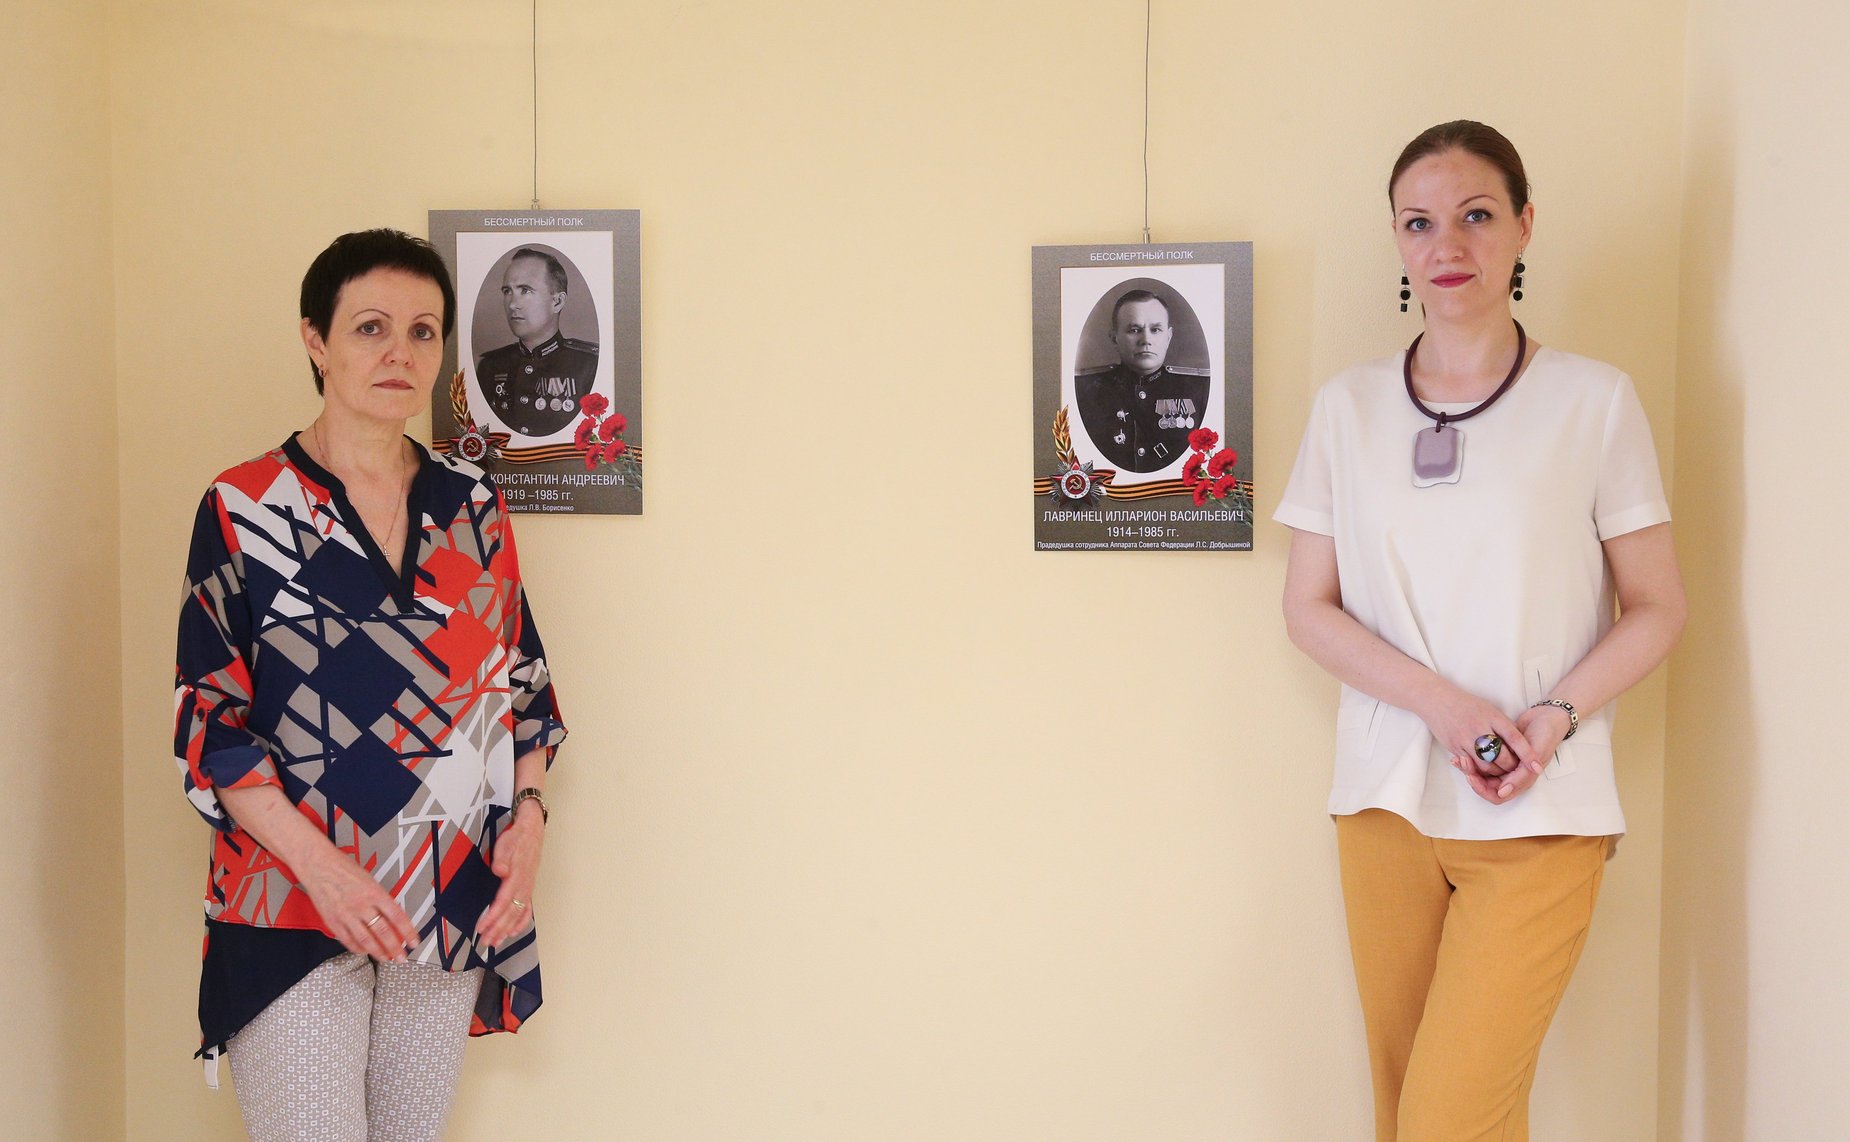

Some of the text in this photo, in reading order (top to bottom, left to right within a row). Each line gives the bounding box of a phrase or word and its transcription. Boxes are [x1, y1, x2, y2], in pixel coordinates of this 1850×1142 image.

[484, 216, 584, 226] БЕССМЕРТНЫЙ ПОЛК
[1090, 250, 1194, 261] БЕССМЕРТНЫЙ ПОЛК
[490, 473, 626, 487] КОНСТАНТИН АНДРЕЕВИЧ
[502, 489, 526, 500] 1919
[561, 491, 574, 501] гг.
[542, 504, 575, 512] Борисенко
[1043, 510, 1244, 523] ЛАВРИНЕЦ ИЛЛАРИОН ВАСИЛЬЕВИЧ
[1166, 528, 1180, 537] гг.
[1037, 541, 1074, 549] Прадедушка
[1109, 541, 1138, 549] Аппарата
[1160, 541, 1195, 549] Федерации
[1209, 541, 1251, 549] Добрышиной
